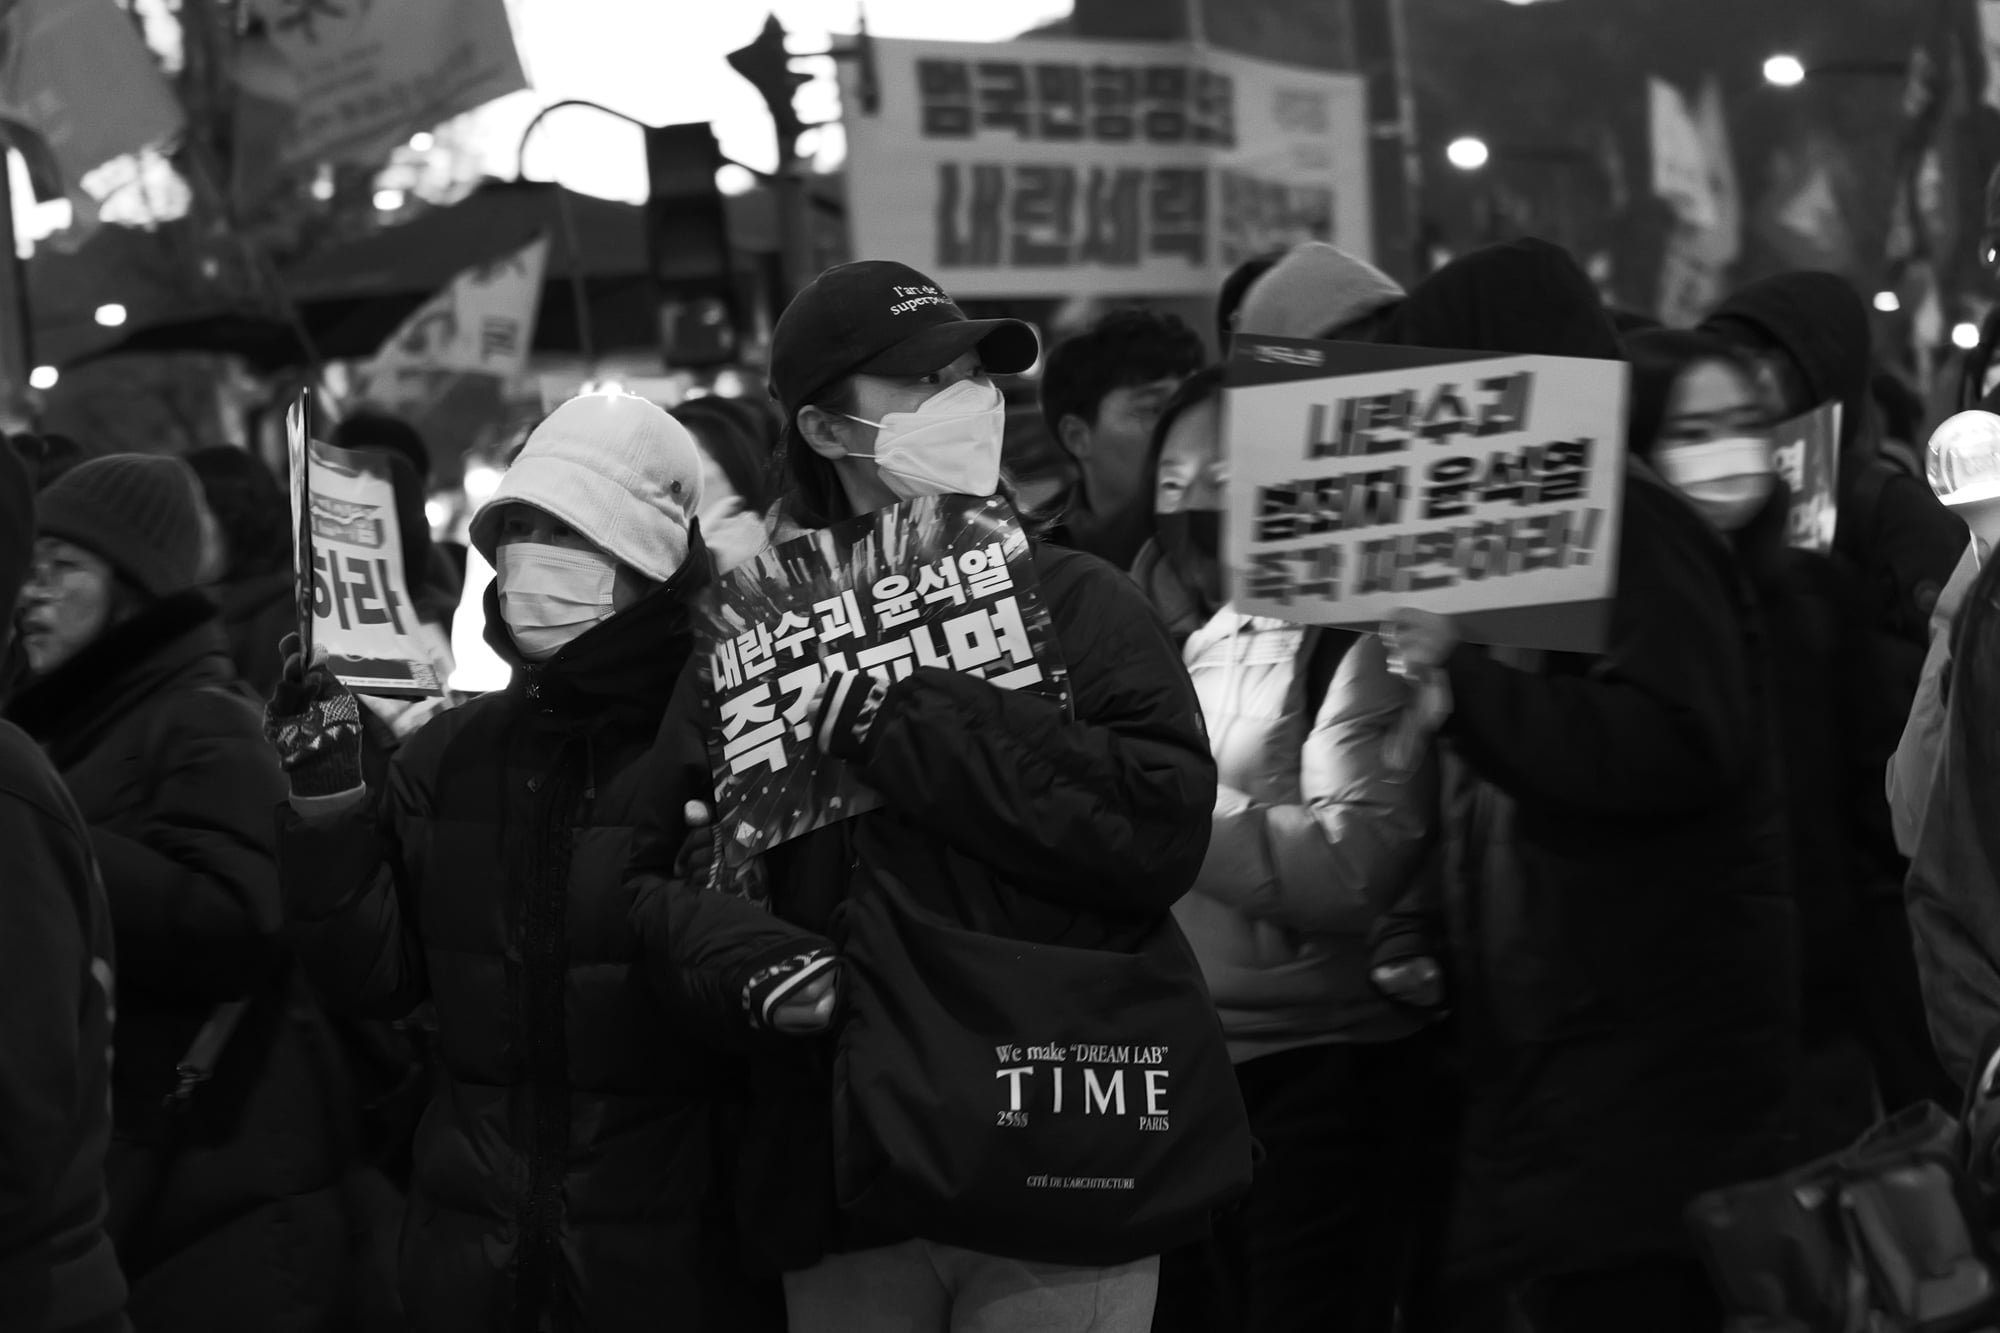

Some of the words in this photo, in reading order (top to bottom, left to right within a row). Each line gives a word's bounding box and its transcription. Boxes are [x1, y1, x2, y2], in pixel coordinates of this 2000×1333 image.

[1420, 436, 1596, 520] 윤석열
[710, 588, 867, 694] 내란수괴
[871, 542, 1015, 631] 윤석열
[996, 1045, 1022, 1063] We
[1028, 1042, 1066, 1061] make
[995, 1066, 1170, 1116] TIME
[1139, 1116, 1170, 1131] PARIS
[1027, 1174, 1047, 1187] CITÉ
[1050, 1176, 1062, 1188] DE
[1063, 1178, 1135, 1189] L'ARCHITECTURE
